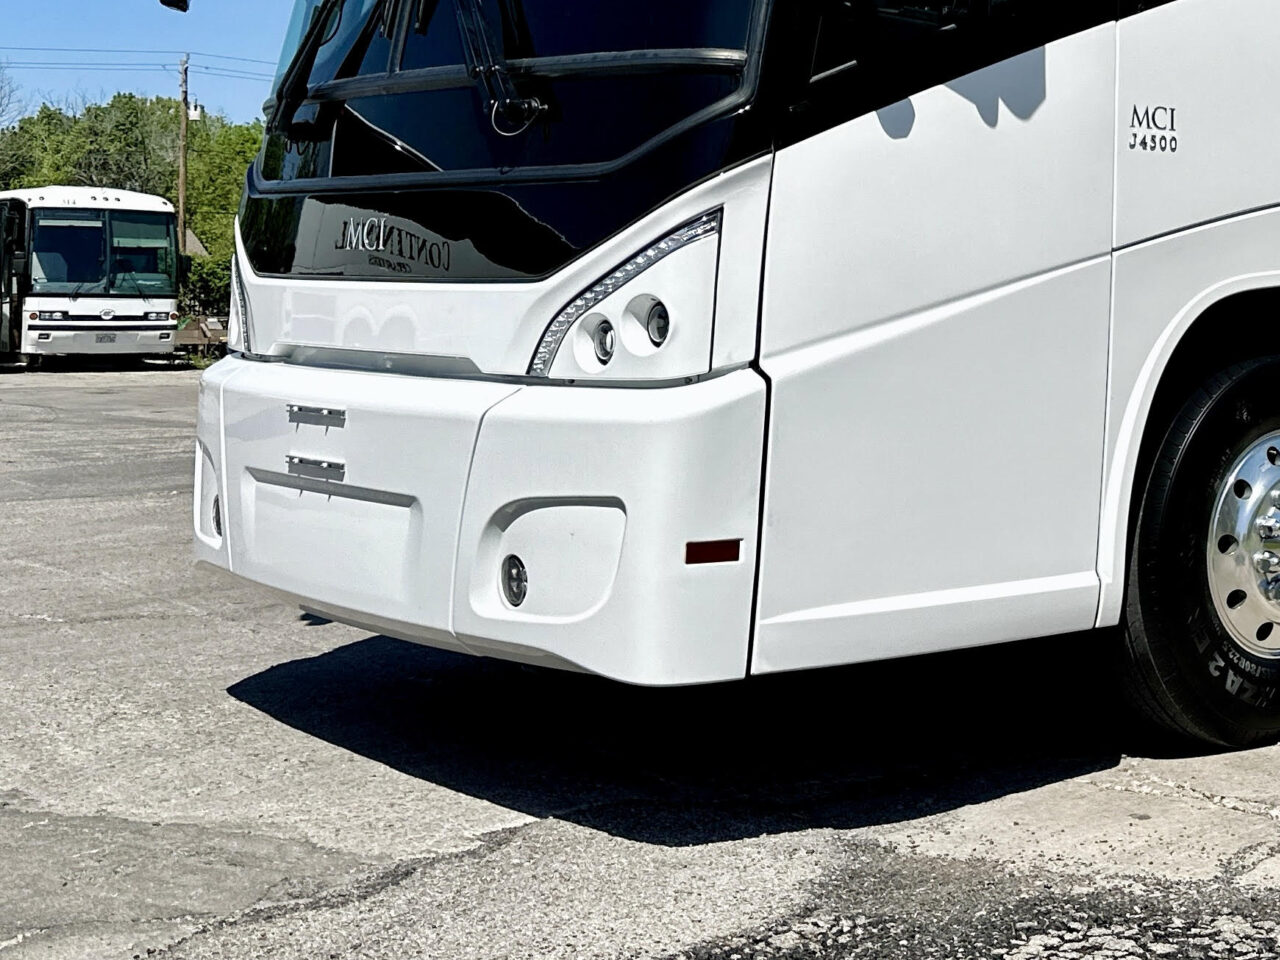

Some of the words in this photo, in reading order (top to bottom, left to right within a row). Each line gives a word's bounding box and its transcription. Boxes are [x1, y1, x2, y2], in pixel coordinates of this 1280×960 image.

[1129, 104, 1176, 131] MCI
[1129, 133, 1178, 153] J4500
[345, 217, 386, 251] MCI
